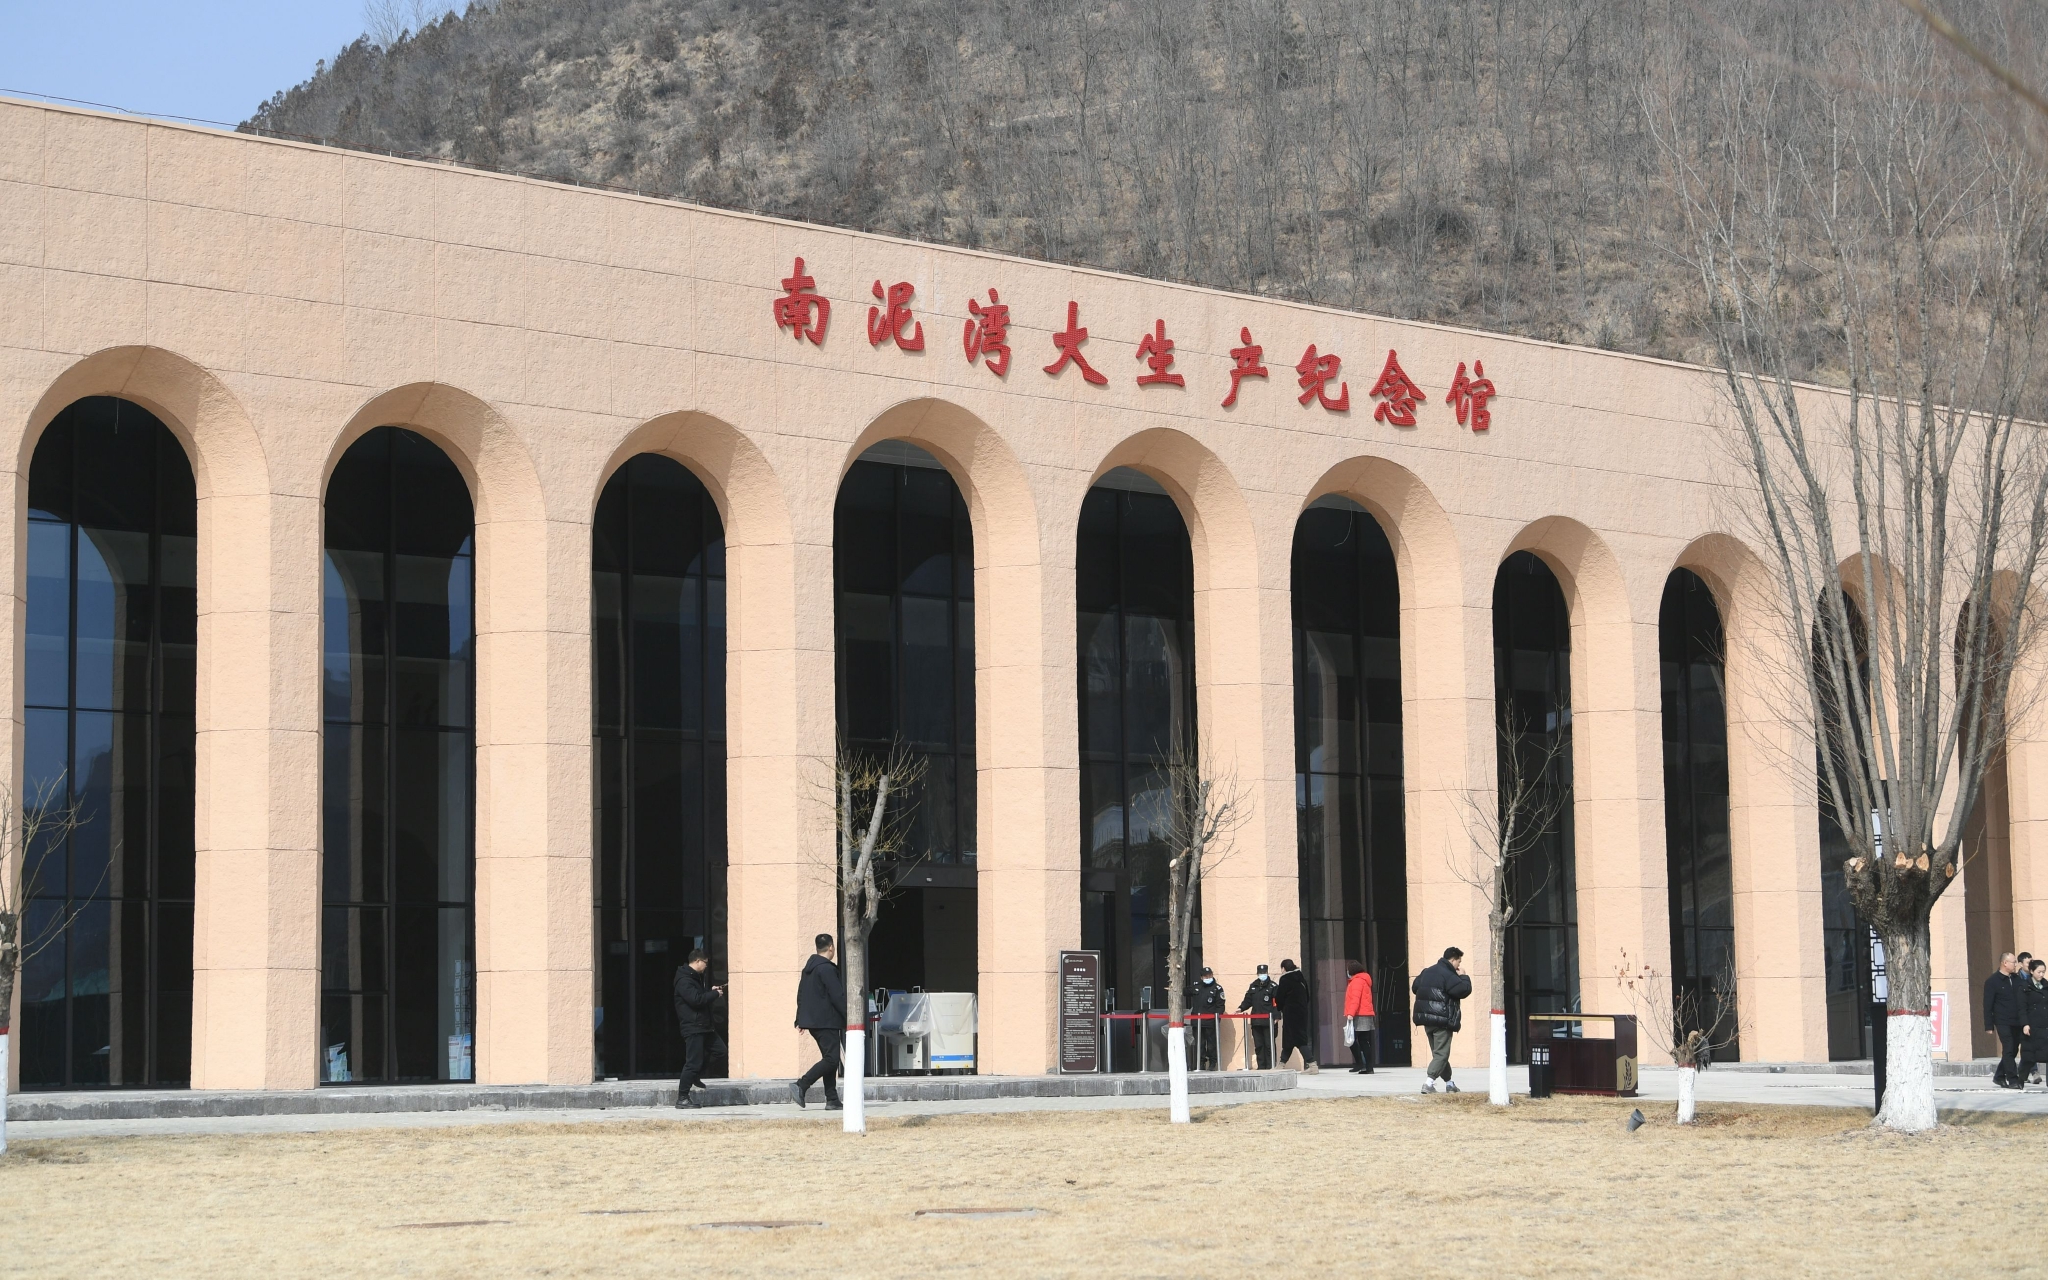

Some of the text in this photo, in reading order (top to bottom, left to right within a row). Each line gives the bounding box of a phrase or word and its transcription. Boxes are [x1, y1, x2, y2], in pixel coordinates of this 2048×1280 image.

[773, 257, 1497, 433] 南泥湾大生产纪念馆
